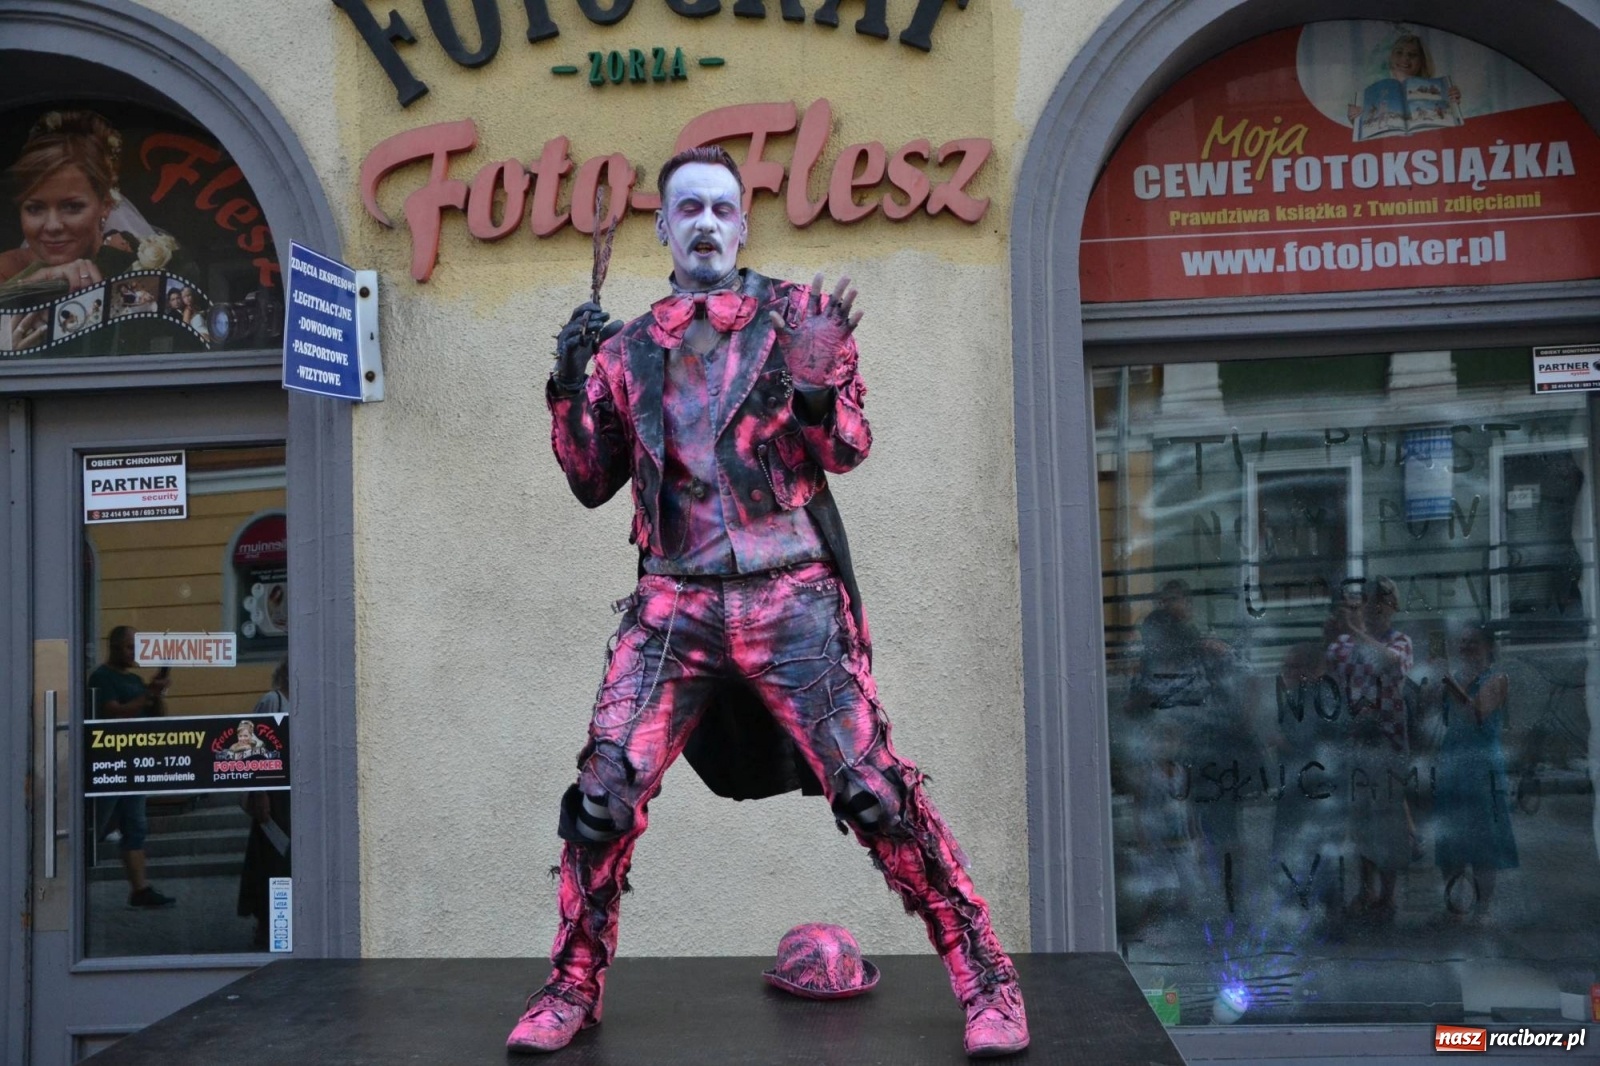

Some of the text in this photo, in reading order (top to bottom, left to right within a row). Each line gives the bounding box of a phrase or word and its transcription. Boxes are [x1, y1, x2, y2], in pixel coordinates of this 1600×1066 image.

[588, 47, 688, 86] ZORZA
[1200, 115, 1308, 181] Moja
[1133, 139, 1576, 200] CEWE FOTOKSIĄŻKA
[1169, 191, 1541, 226] Prawdziwa książka z Twoimi zdjęciami
[1181, 230, 1506, 277] www.fotojoker.pl
[291, 257, 356, 293] ZDJĘCIA EKSPRESOWE
[1538, 362, 1589, 371] PARTNER
[91, 455, 178, 467] OBIEKT CHRONIONY
[91, 475, 178, 492] PARTNER
[142, 493, 179, 501] security
[140, 638, 233, 663] ZAMKNIĘTE
[91, 730, 206, 752] Zapraszamy
[211, 723, 283, 753] Foto Flesz
[92, 759, 127, 772] pon-pt:
[133, 757, 155, 768] 9.00
[164, 755, 191, 767] 17.00
[213, 759, 283, 772] FOTOJOKER
[92, 772, 195, 785] sobota: na zamówienie
[213, 772, 254, 782] partner
